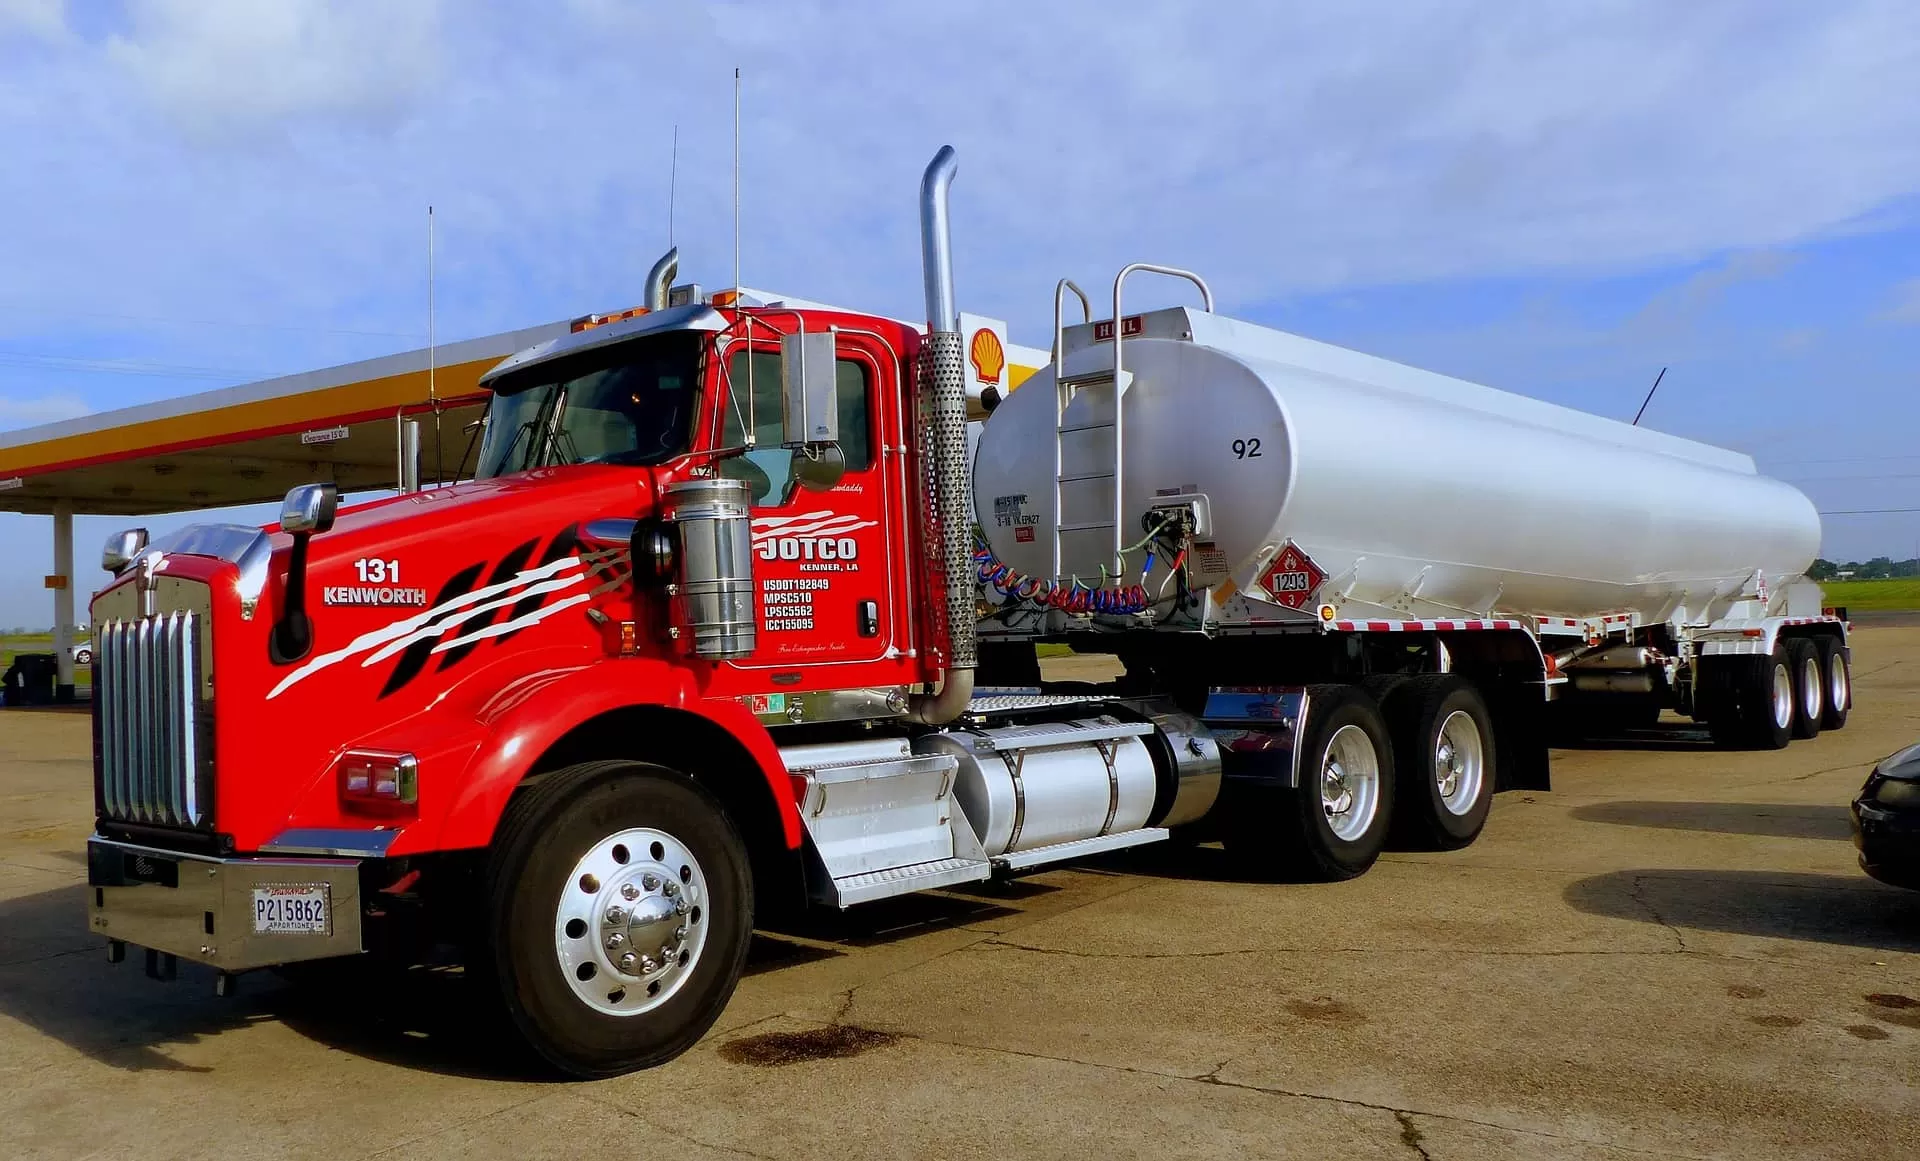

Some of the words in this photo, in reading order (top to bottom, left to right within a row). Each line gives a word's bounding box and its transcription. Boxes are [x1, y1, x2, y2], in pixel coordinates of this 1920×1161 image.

[1100, 320, 1136, 337] HIL
[1232, 438, 1262, 460] 92
[760, 537, 857, 560] JOTCO
[354, 558, 399, 583] 131
[799, 563, 844, 572] KENNER,
[847, 563, 859, 571] LA
[763, 578, 829, 591] USDOT192849
[1275, 572, 1306, 591] 1203
[324, 587, 427, 605] KENWORTH
[764, 592, 812, 604] MPSC510
[1288, 594, 1295, 606] 3
[765, 605, 813, 617] LPSC5562
[765, 618, 814, 631] ICC155095
[257, 899, 323, 922] P215862
